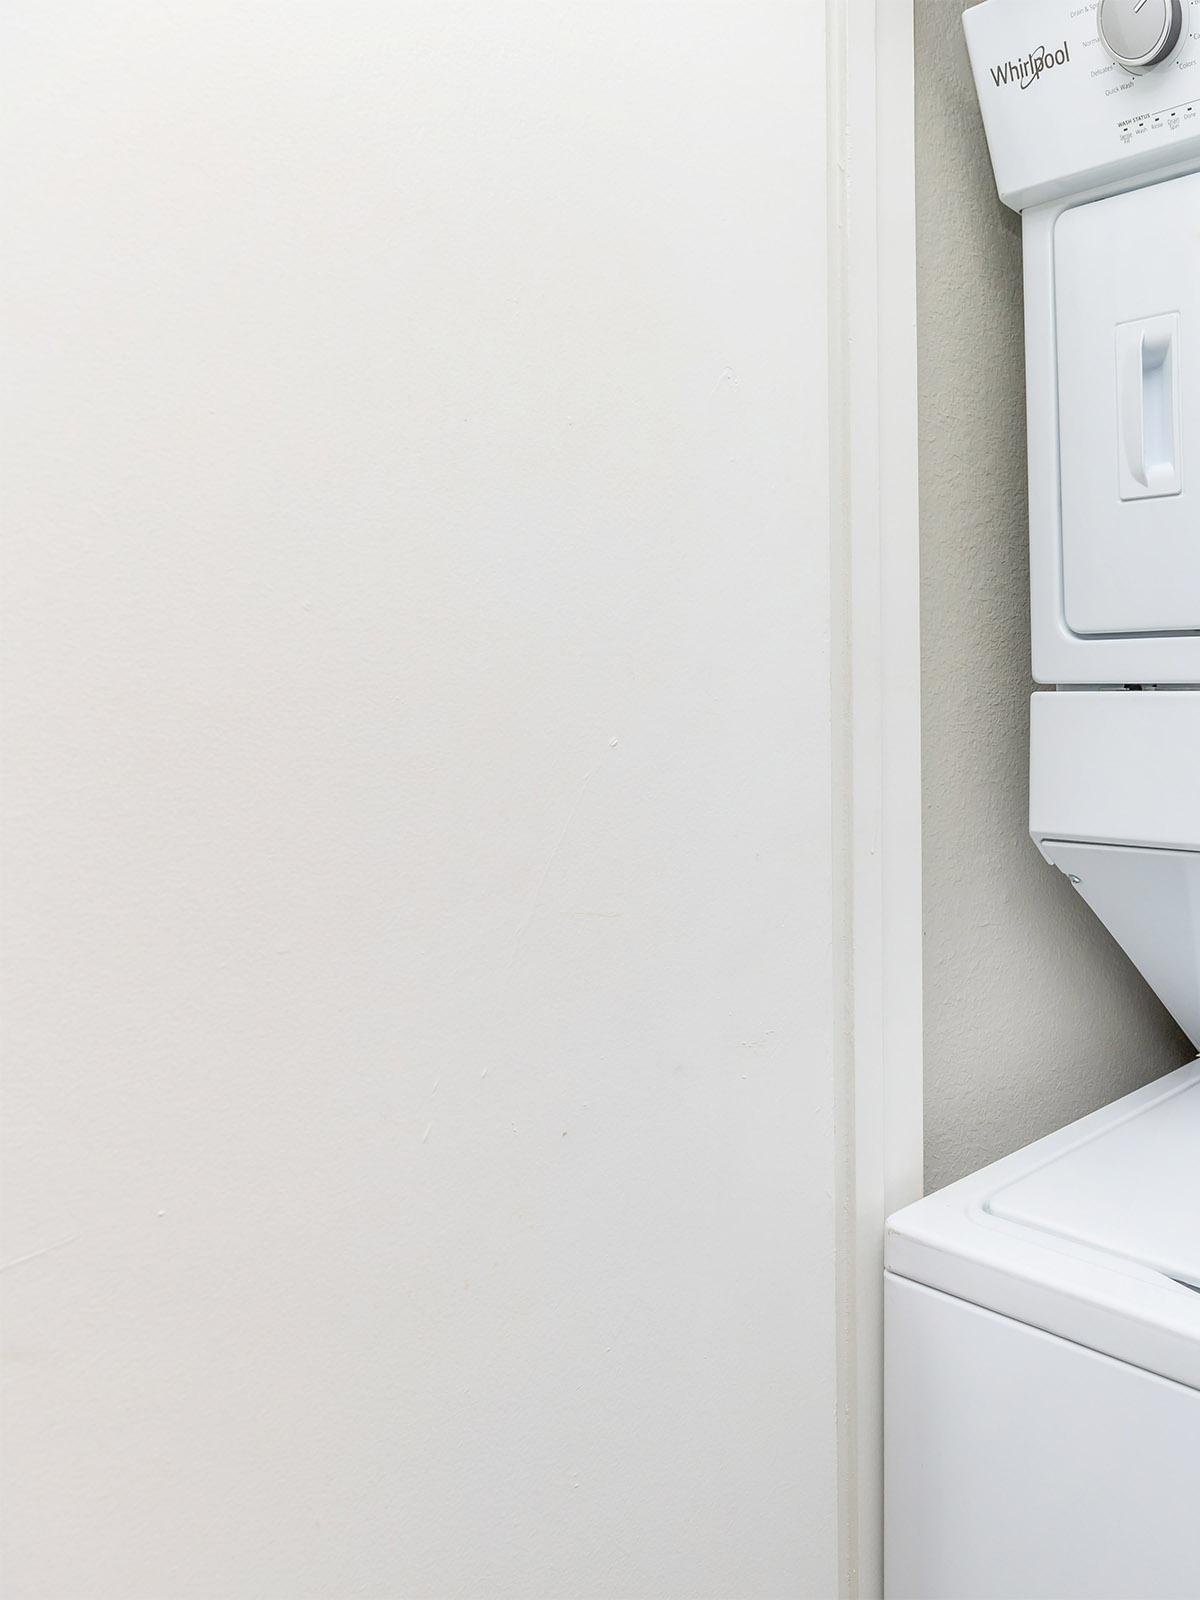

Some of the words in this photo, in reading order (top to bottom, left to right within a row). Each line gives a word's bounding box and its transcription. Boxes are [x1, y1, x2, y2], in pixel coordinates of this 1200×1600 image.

[1082, 37, 1100, 48] Norma
[990, 41, 1070, 90] Whirlpool
[1119, 81, 1135, 92] Wash
[1118, 119, 1132, 128] WASH
[1132, 113, 1151, 123] STATUS
